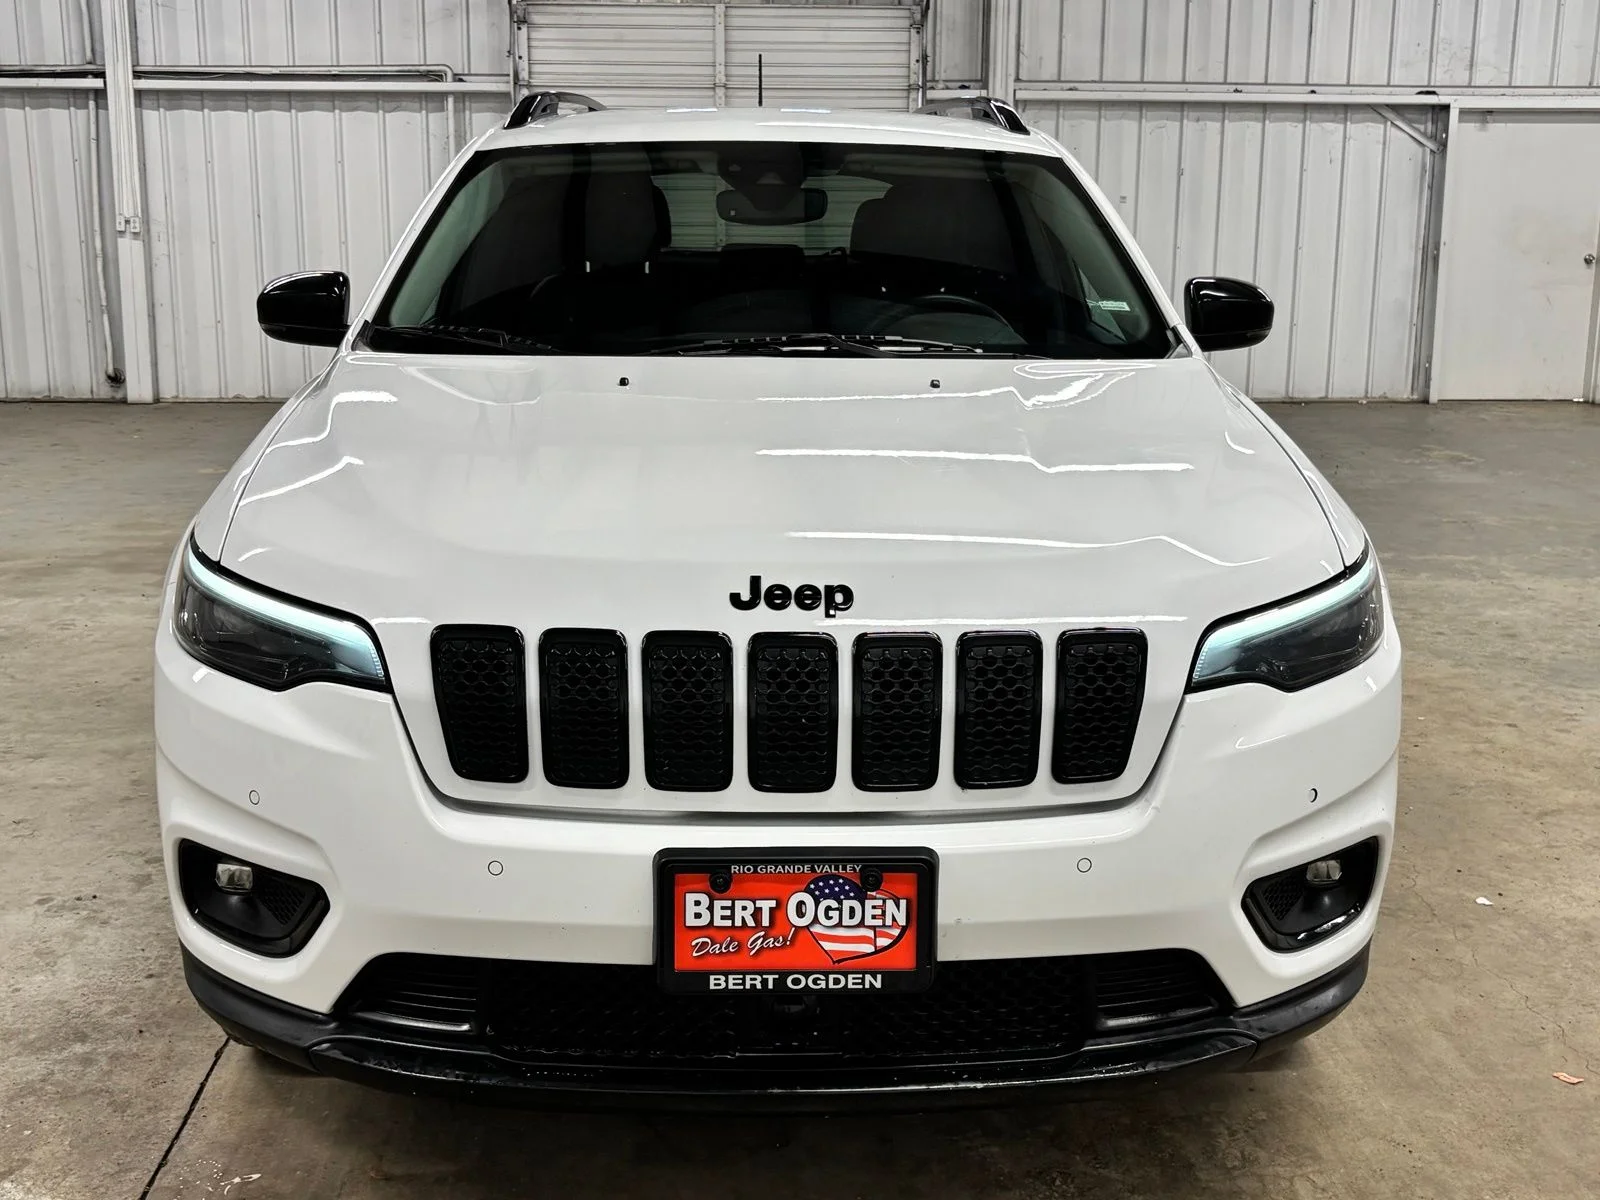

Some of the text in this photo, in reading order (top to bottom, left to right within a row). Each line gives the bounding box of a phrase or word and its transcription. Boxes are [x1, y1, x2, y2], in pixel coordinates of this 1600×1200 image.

[729, 575, 854, 618] Jeep
[730, 864, 862, 874] RIO GRANDE VALLEY
[684, 891, 908, 927] BERT OGDEN
[691, 927, 796, 957] Dale Gas!
[709, 973, 882, 990] BERT OGDEN
